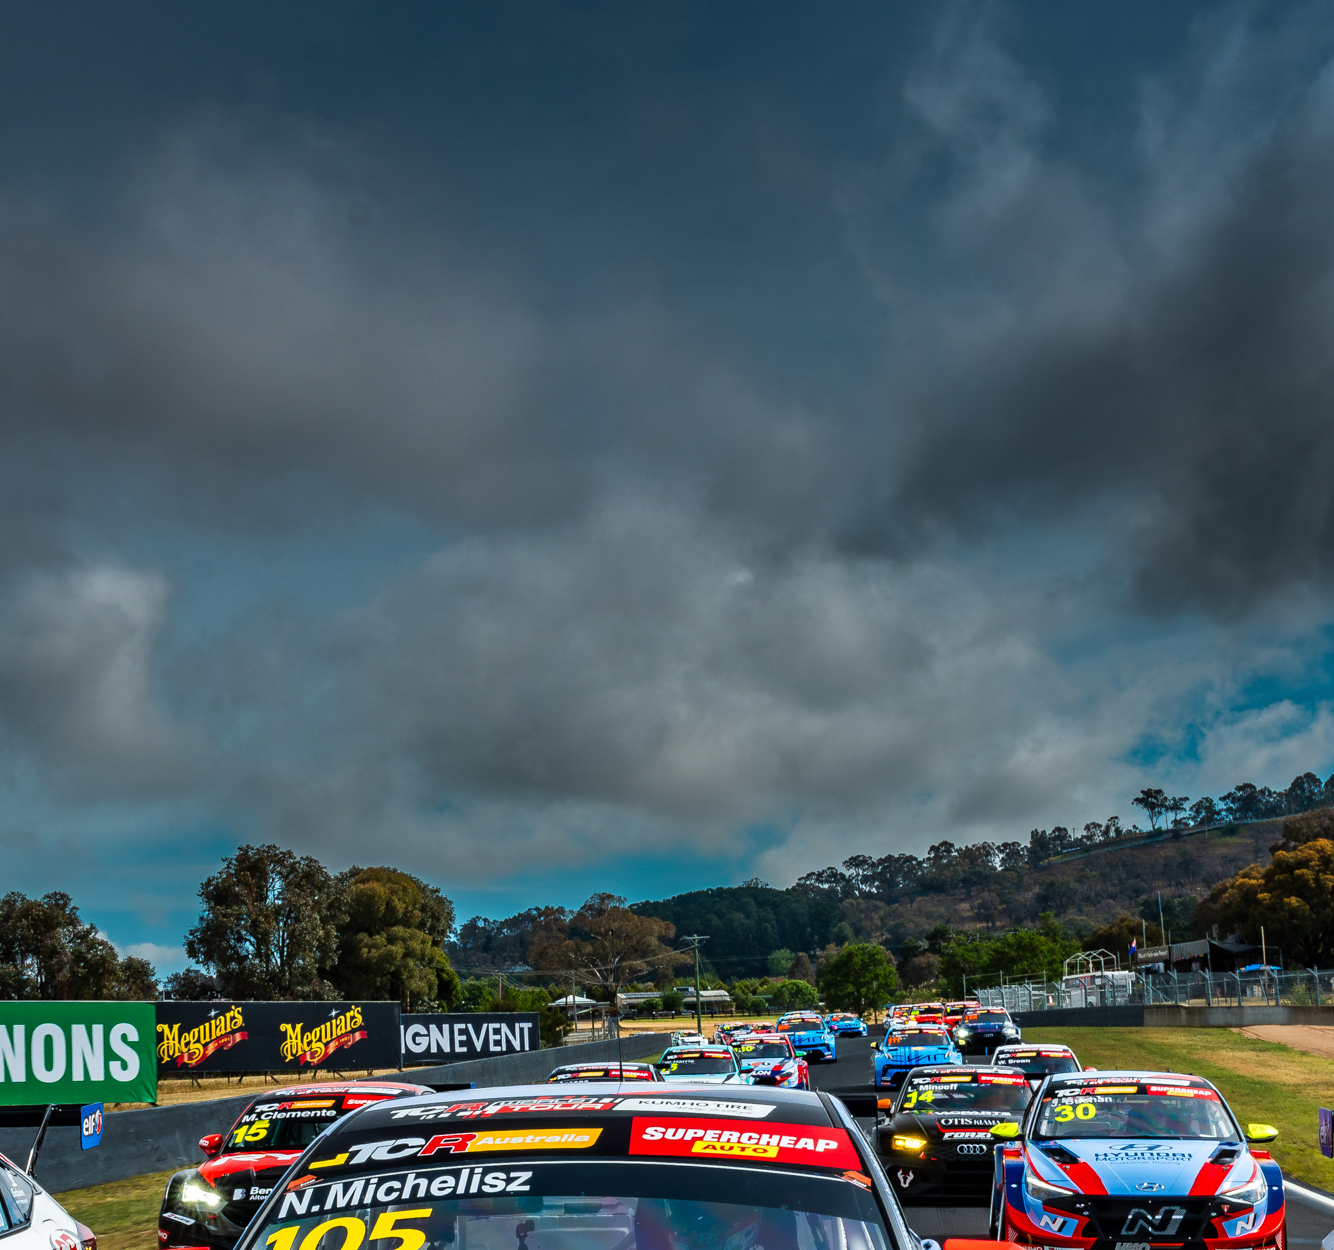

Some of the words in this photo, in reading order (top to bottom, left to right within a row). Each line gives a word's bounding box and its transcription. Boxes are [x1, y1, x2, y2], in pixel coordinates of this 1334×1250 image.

[156, 1005, 245, 1064] Meguiar's
[280, 1005, 364, 1064] Meguiar's
[907, 1090, 935, 1104] 14
[1055, 1087, 1098, 1097] TCR
[1150, 1086, 1212, 1096] SUPERCHEAP
[255, 1101, 296, 1112] TCR
[390, 1102, 488, 1120] TCR
[513, 1102, 605, 1111] TOUR
[1055, 1103, 1097, 1122] 30
[83, 1115, 96, 1136] elf
[941, 1118, 973, 1126] OTIS
[233, 1120, 270, 1144] 15
[642, 1127, 838, 1152] SUPERCHEAP
[349, 1132, 478, 1166] TCR
[476, 1133, 590, 1146] Australia
[701, 1143, 768, 1154] AUTO
